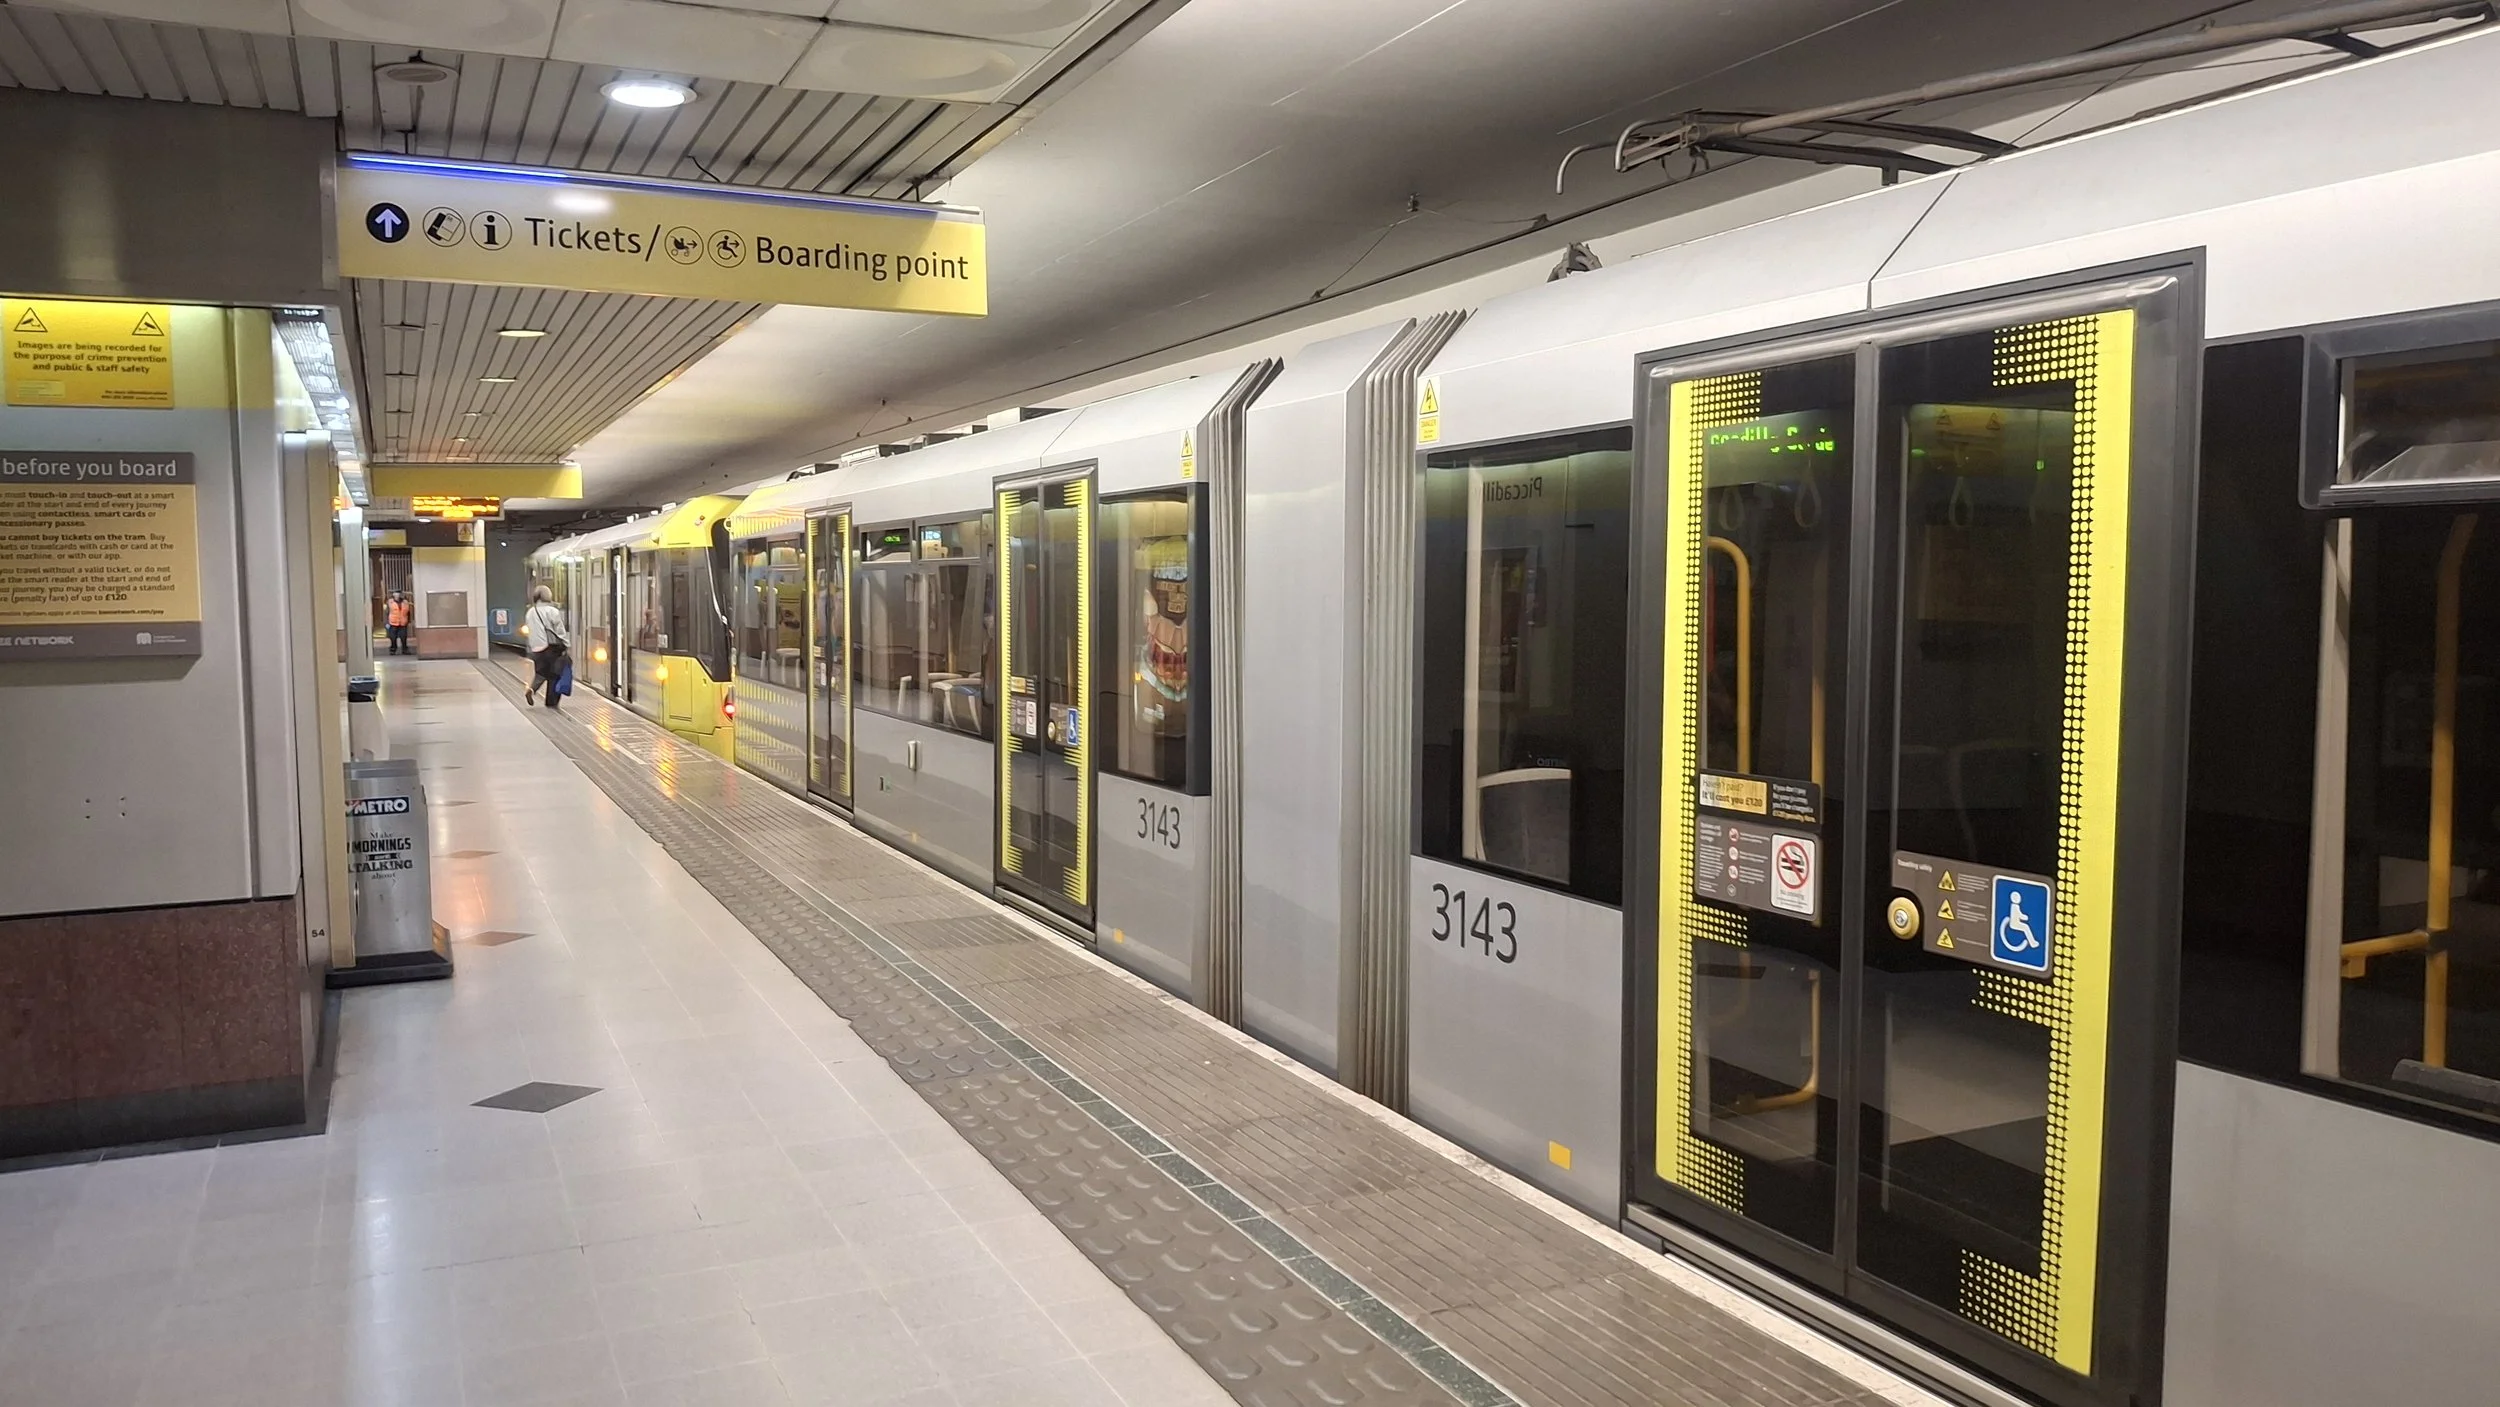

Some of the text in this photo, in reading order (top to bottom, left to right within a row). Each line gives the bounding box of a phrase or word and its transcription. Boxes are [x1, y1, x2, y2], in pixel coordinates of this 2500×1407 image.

[524, 217, 969, 282] Tickets/ Boarding point
[17, 340, 54, 351] Images
[75, 342, 102, 353] being
[105, 344, 146, 352] recorded
[13, 352, 30, 360] the
[33, 353, 72, 361] purpose
[87, 354, 114, 362] crime
[117, 355, 167, 363] prevention
[53, 363, 83, 372] public
[86, 364, 93, 372] &
[96, 364, 118, 372] staff
[121, 365, 150, 374] safety
[2, 457, 177, 480] before you board
[28, 491, 68, 499] touch-in
[87, 491, 132, 499] touch-out
[112, 502, 134, 510] every
[136, 501, 167, 510] journey
[8, 533, 40, 541] cannot
[42, 533, 59, 542] buy
[61, 533, 92, 541] tickets
[107, 533, 122, 541] the
[150, 532, 166, 542] Buy
[130, 542, 149, 550] card
[160, 542, 174, 550] the
[16, 566, 41, 574] travel
[42, 566, 75, 574] without
[8, 575, 22, 583] the
[51, 575, 78, 583] reader
[48, 586, 64, 595] you
[66, 586, 83, 594] may
[98, 584, 131, 594] charged
[14, 635, 75, 646] NETWORK
[354, 798, 407, 815] METRO
[1731, 796, 1744, 806] you
[1137, 797, 1181, 850] 3143
[370, 831, 394, 839] Make
[352, 837, 411, 853] MORNINGS
[355, 860, 413, 873] TALKING
[1431, 882, 1518, 964] 3143
[311, 928, 325, 938] 54
